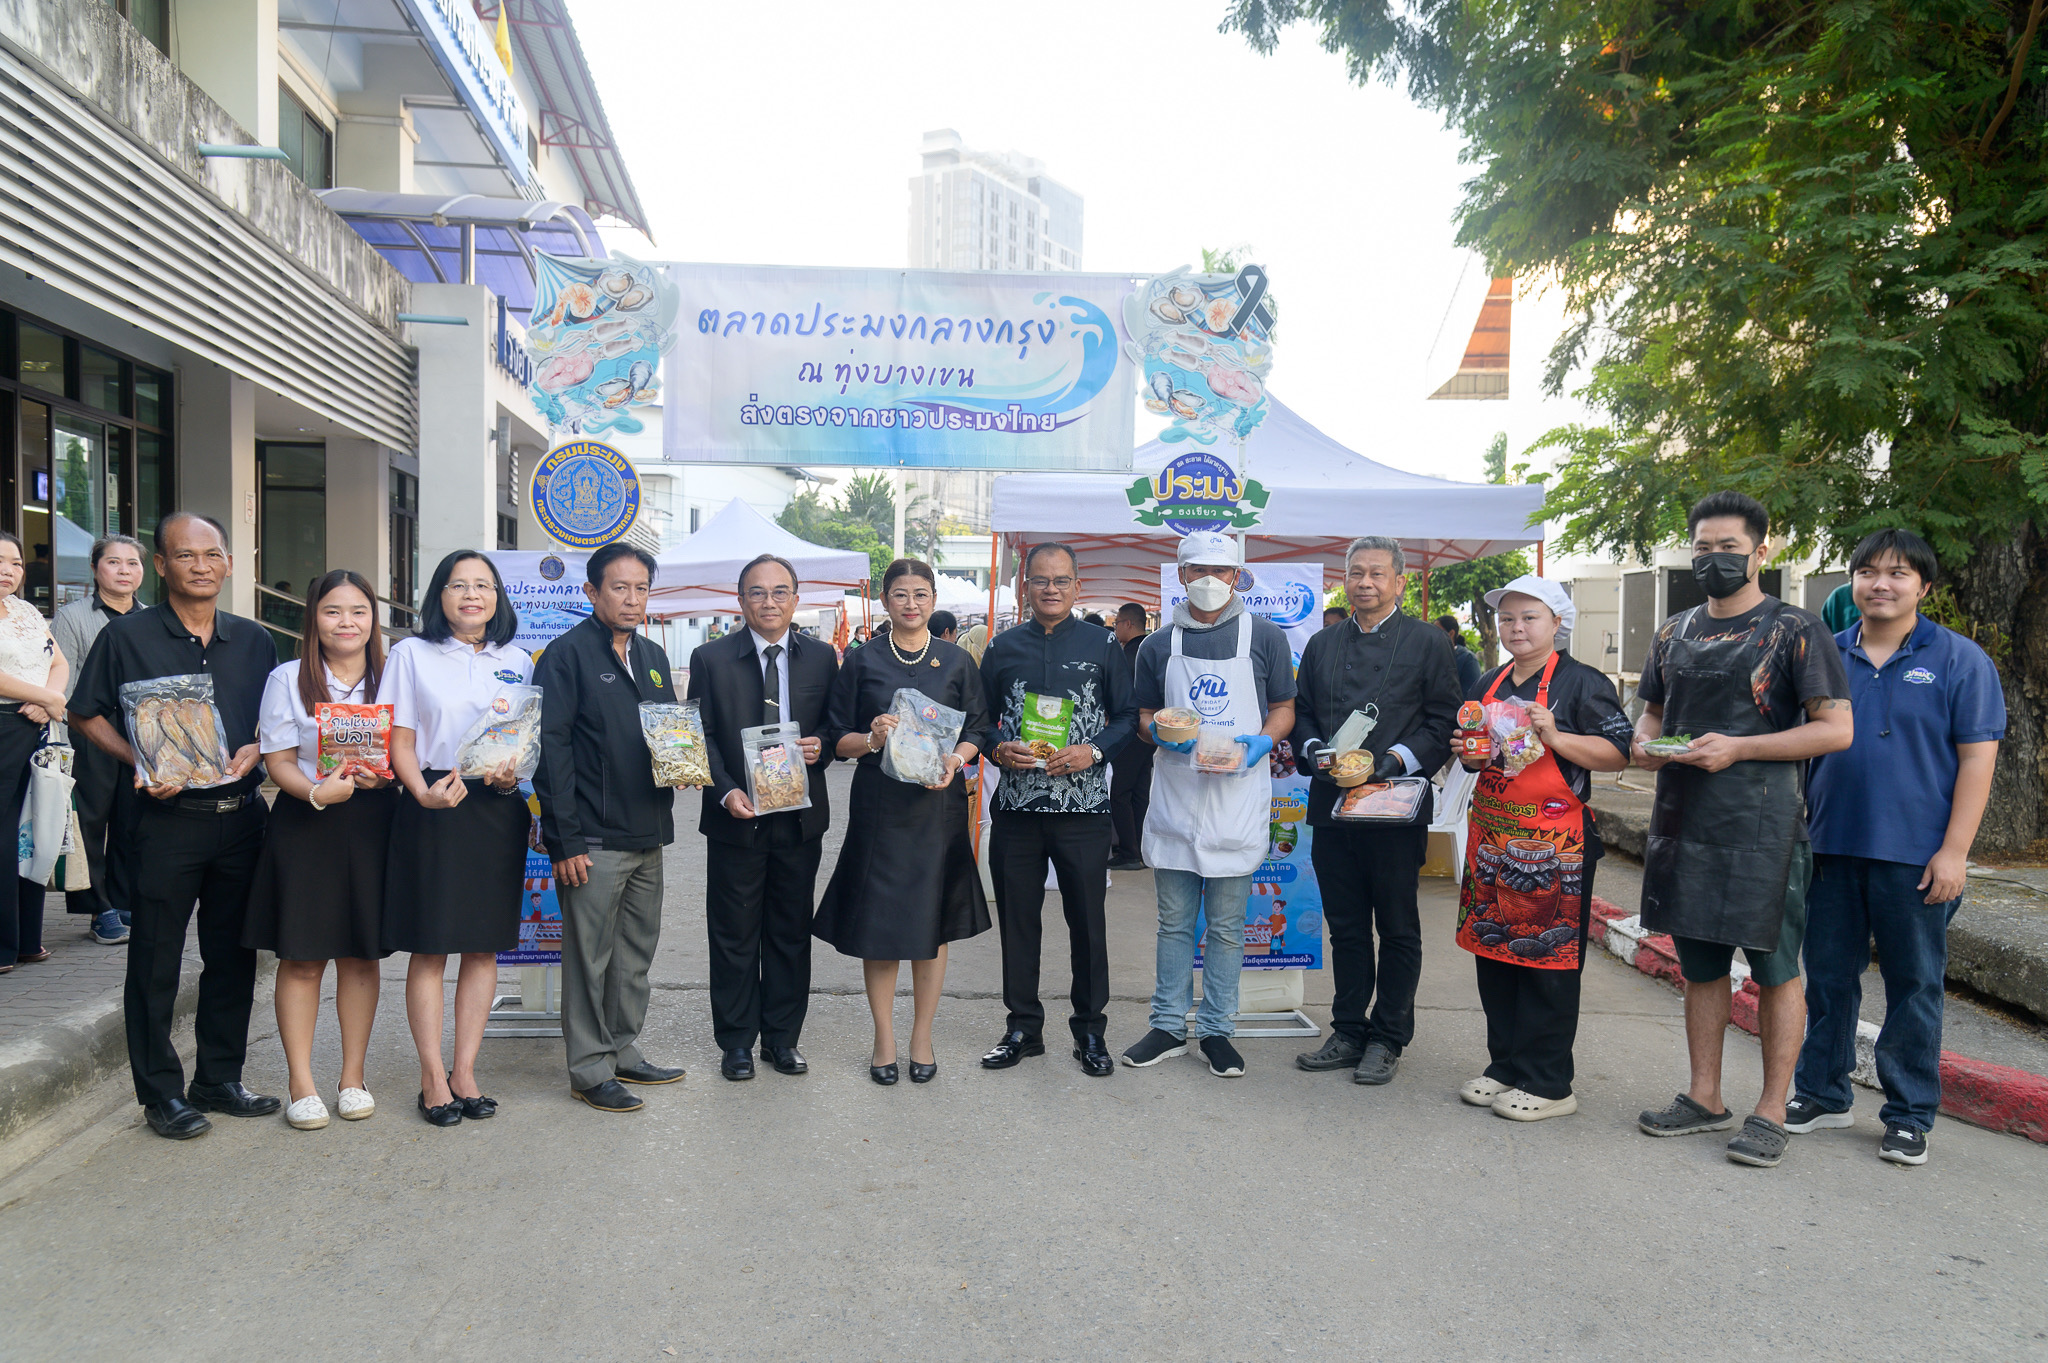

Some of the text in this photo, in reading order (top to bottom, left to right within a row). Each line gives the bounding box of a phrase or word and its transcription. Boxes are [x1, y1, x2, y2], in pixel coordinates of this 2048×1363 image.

[698, 302, 1056, 360] ตลาดประมงกลางกรุง
[798, 348, 975, 395] ณ ทุ่งบางเขน
[740, 393, 1057, 432] ส่งตรงจากชาวประมงไทย
[546, 443, 627, 472] กรมประมง
[1153, 468, 1244, 502] ประมง
[536, 499, 636, 545] กระทรวงเกษตรและสหกรณ์
[1178, 506, 1217, 517] ธงเขียว
[331, 713, 378, 730] กุนเชียง
[335, 729, 372, 747] ปลา
[1271, 799, 1300, 808] ประมง
